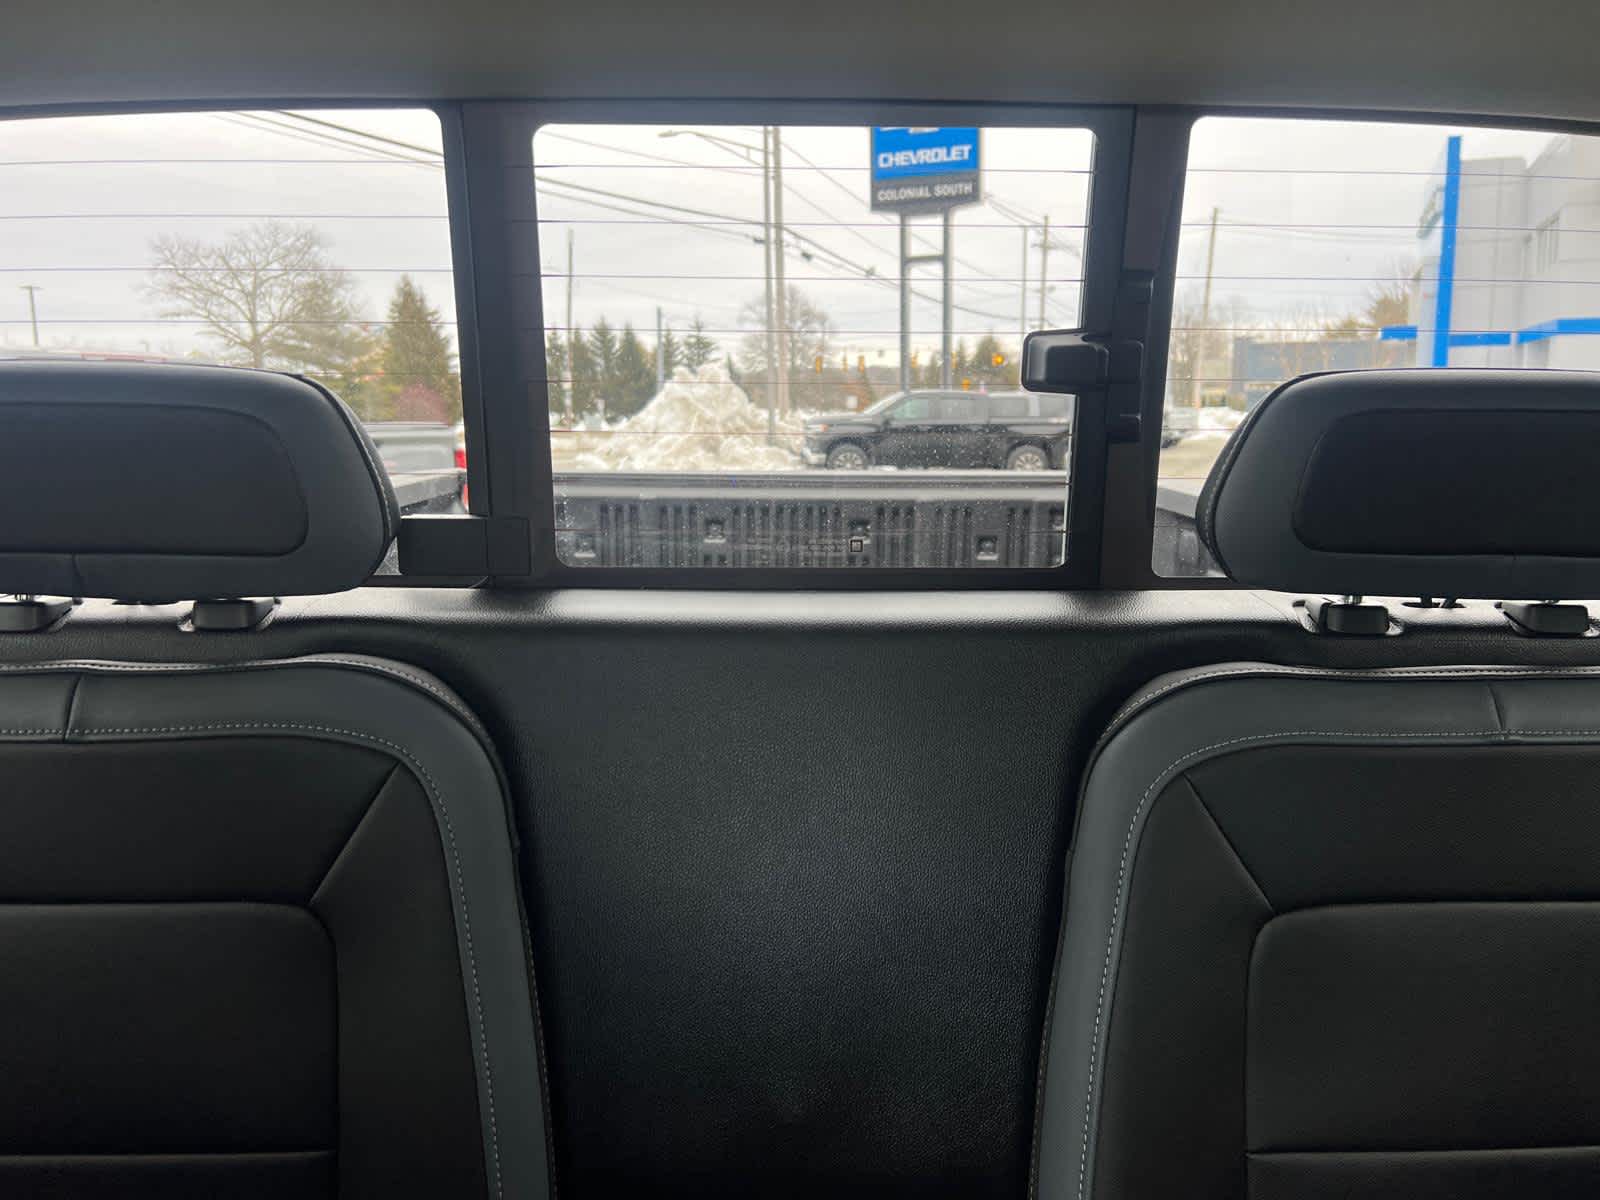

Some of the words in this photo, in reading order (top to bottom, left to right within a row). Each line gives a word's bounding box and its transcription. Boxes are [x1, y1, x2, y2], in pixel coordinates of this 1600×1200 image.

[878, 144, 972, 169] CHEVROLET
[878, 186, 931, 201] COLONIAL
[934, 182, 973, 198] SOUTH
